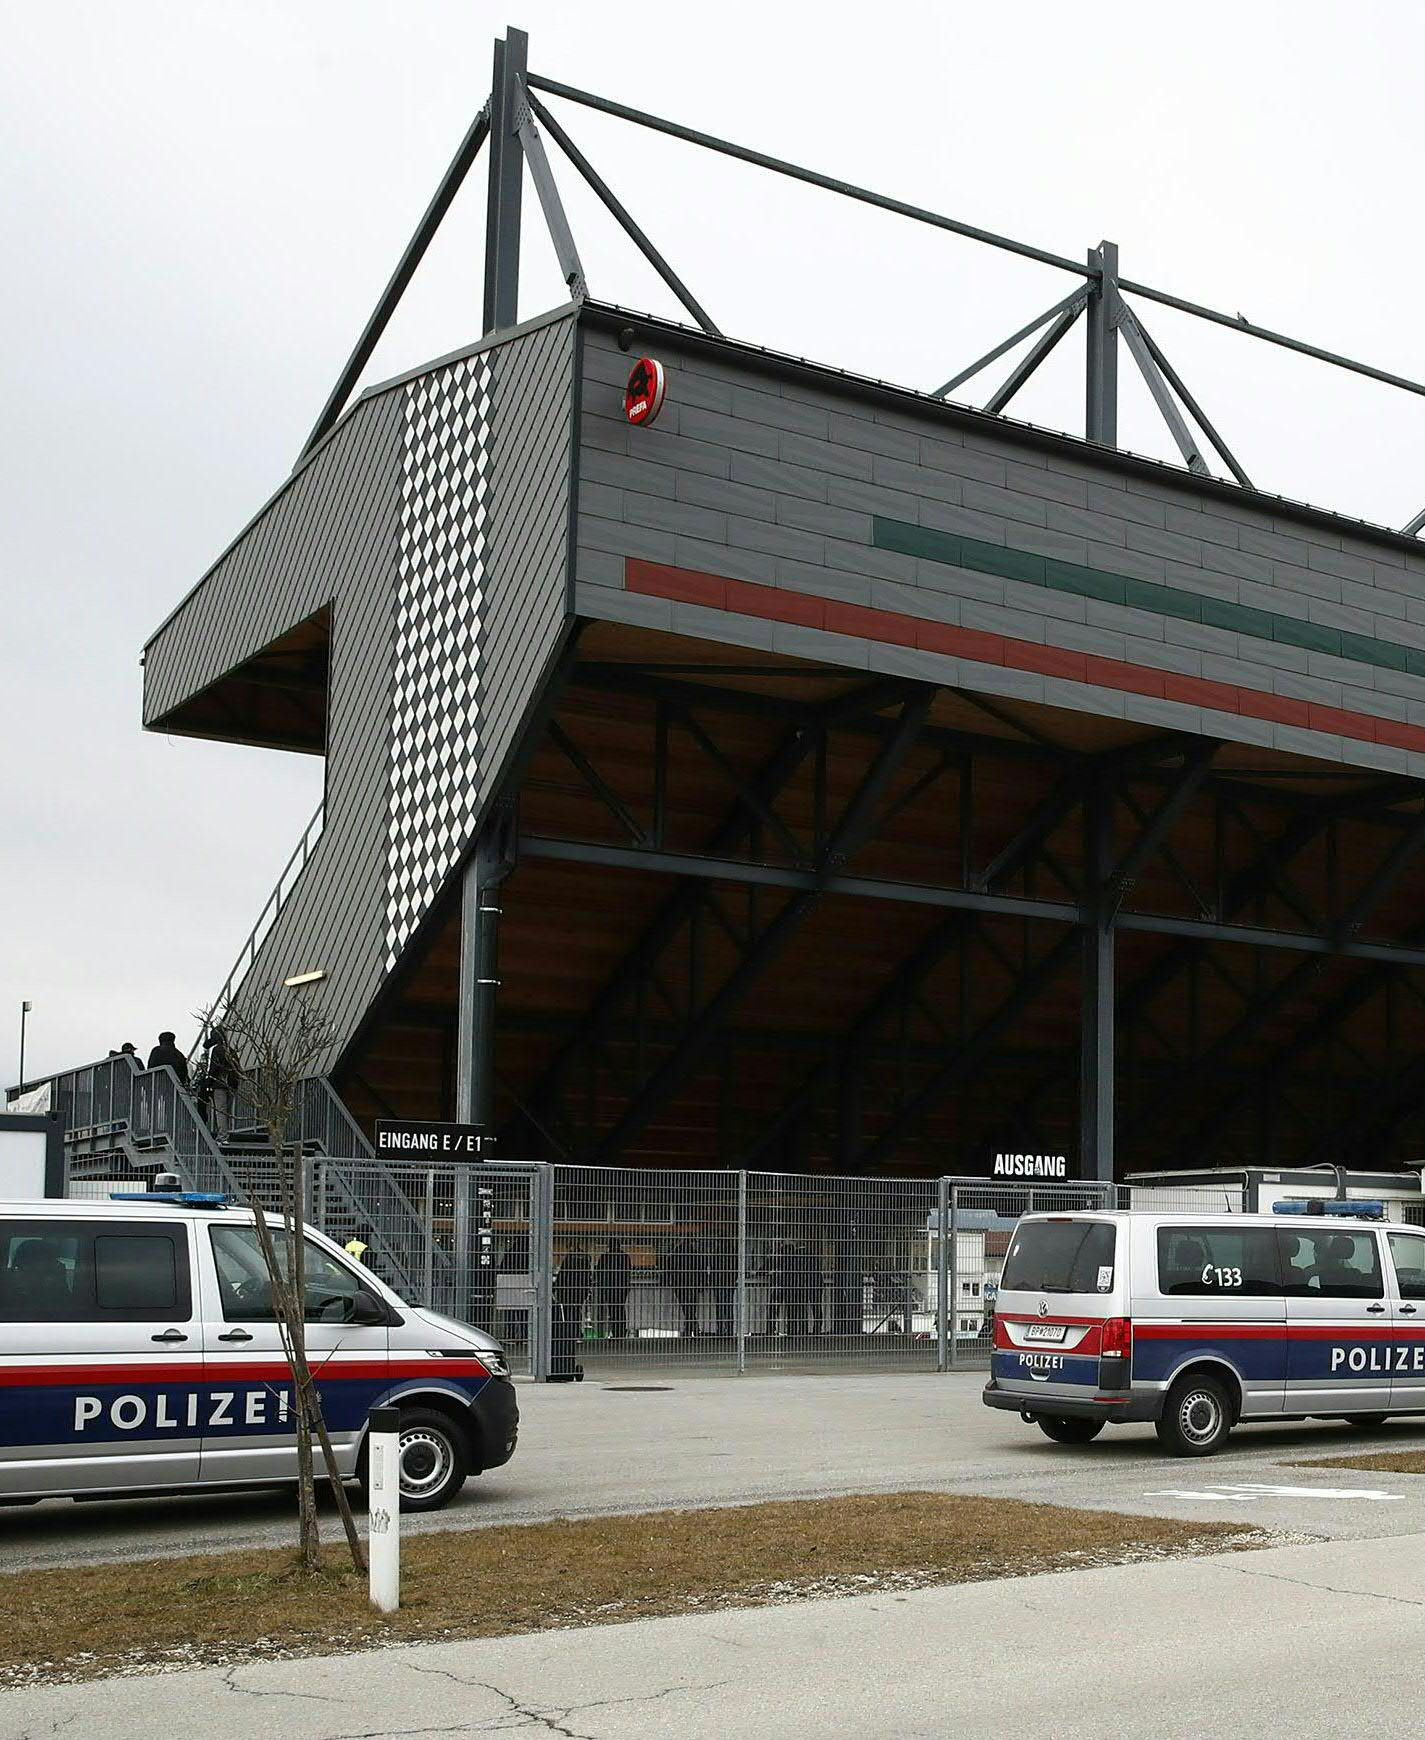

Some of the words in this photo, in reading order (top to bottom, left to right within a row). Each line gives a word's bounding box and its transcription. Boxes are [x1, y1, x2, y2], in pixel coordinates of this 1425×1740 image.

[629, 400, 647, 419] PREFA
[379, 1131, 438, 1150] EINGANG
[443, 1134, 451, 1151] E
[466, 1135, 481, 1152] E1
[993, 1153, 1066, 1177] AUSGANG
[1214, 1267, 1243, 1287] 133
[1019, 1354, 1064, 1369] POLIZEI
[74, 1390, 289, 1431] POLIZEI
